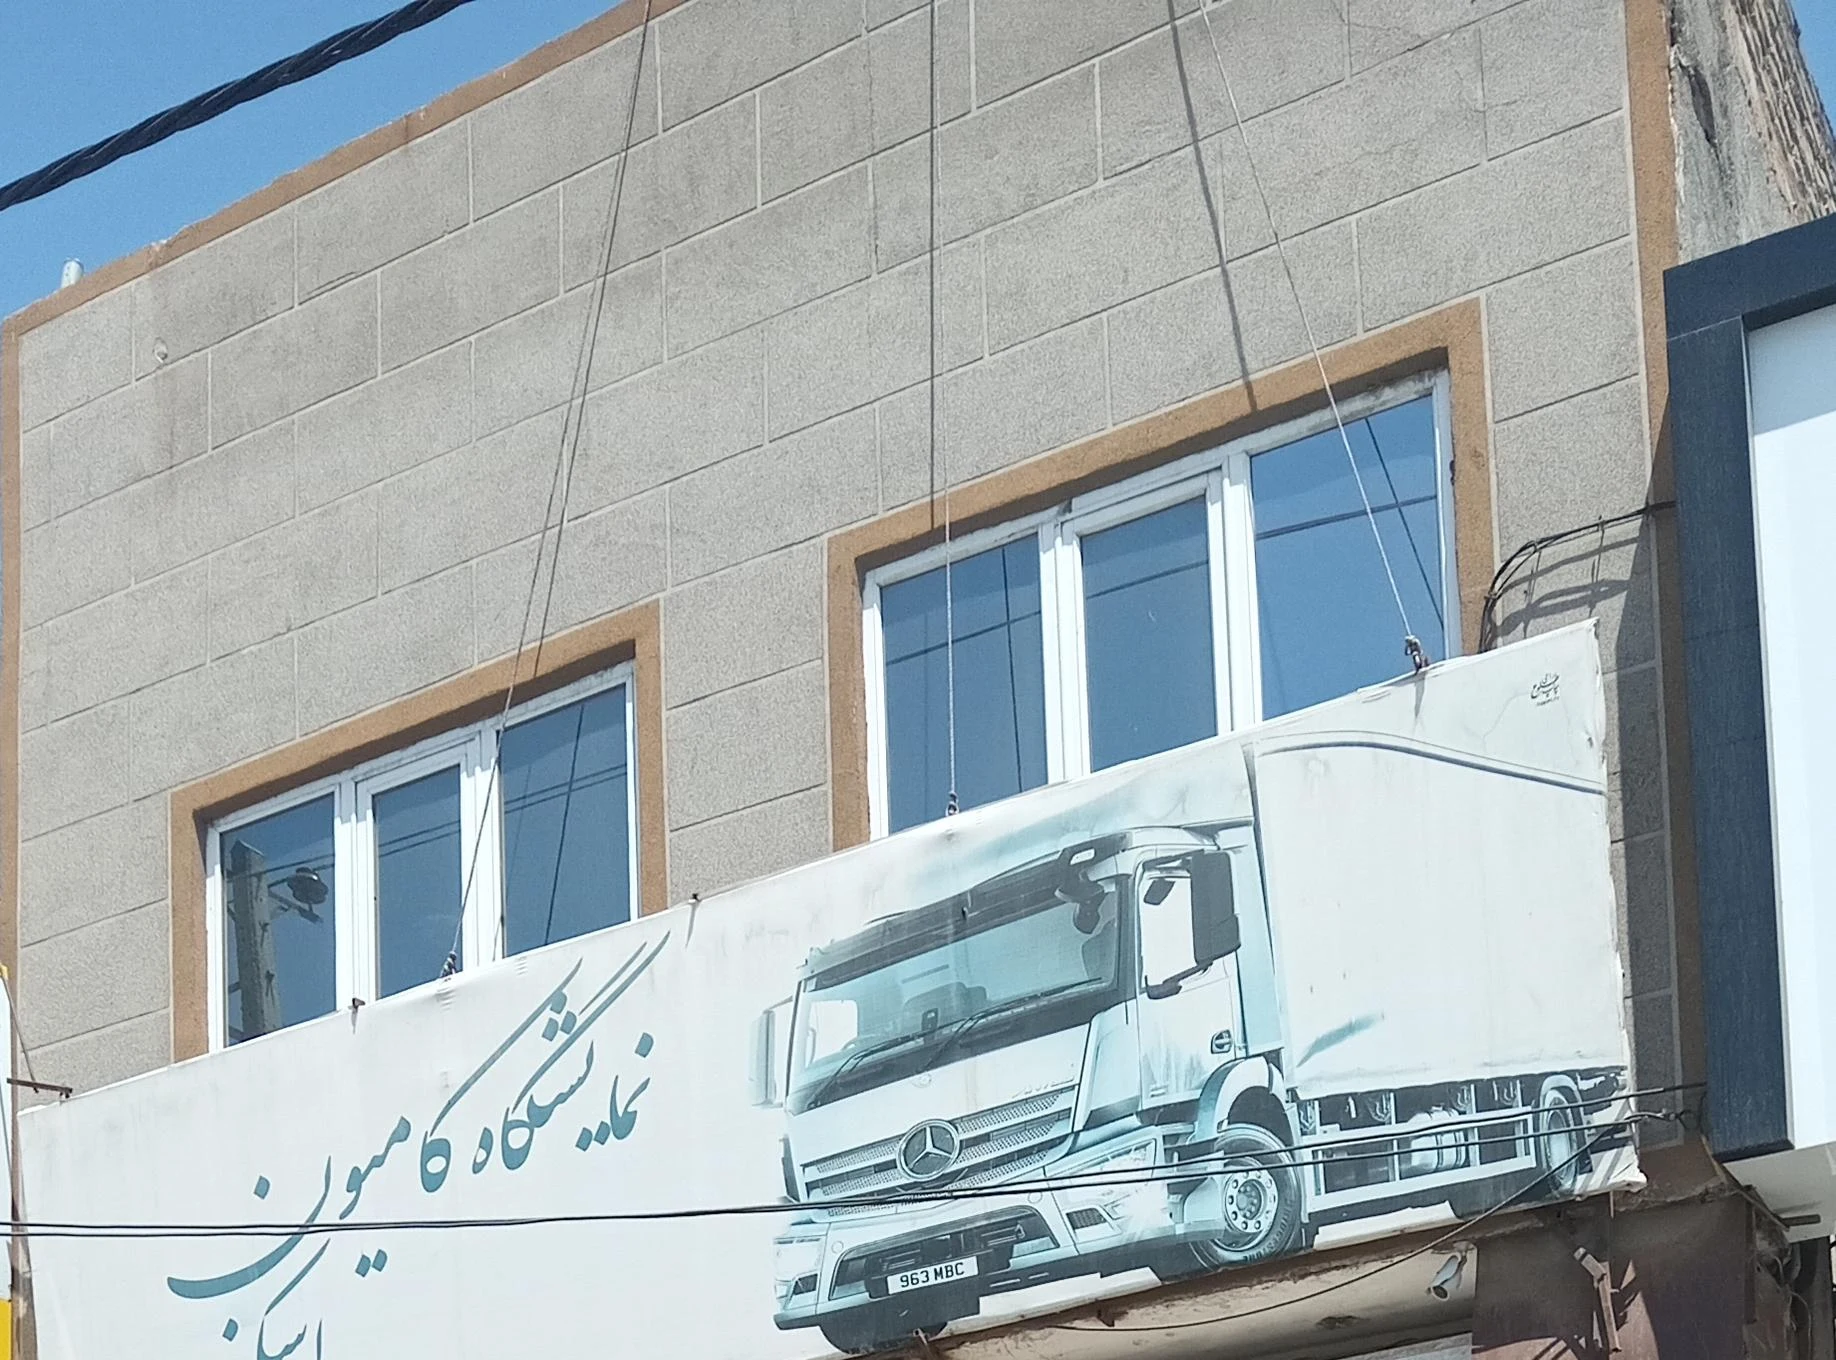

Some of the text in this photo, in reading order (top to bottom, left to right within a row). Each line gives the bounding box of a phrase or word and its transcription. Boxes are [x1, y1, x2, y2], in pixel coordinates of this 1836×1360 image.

[166, 930, 670, 1299] نمایشگاه کامیون
[899, 1262, 965, 1288] 963 MBC
